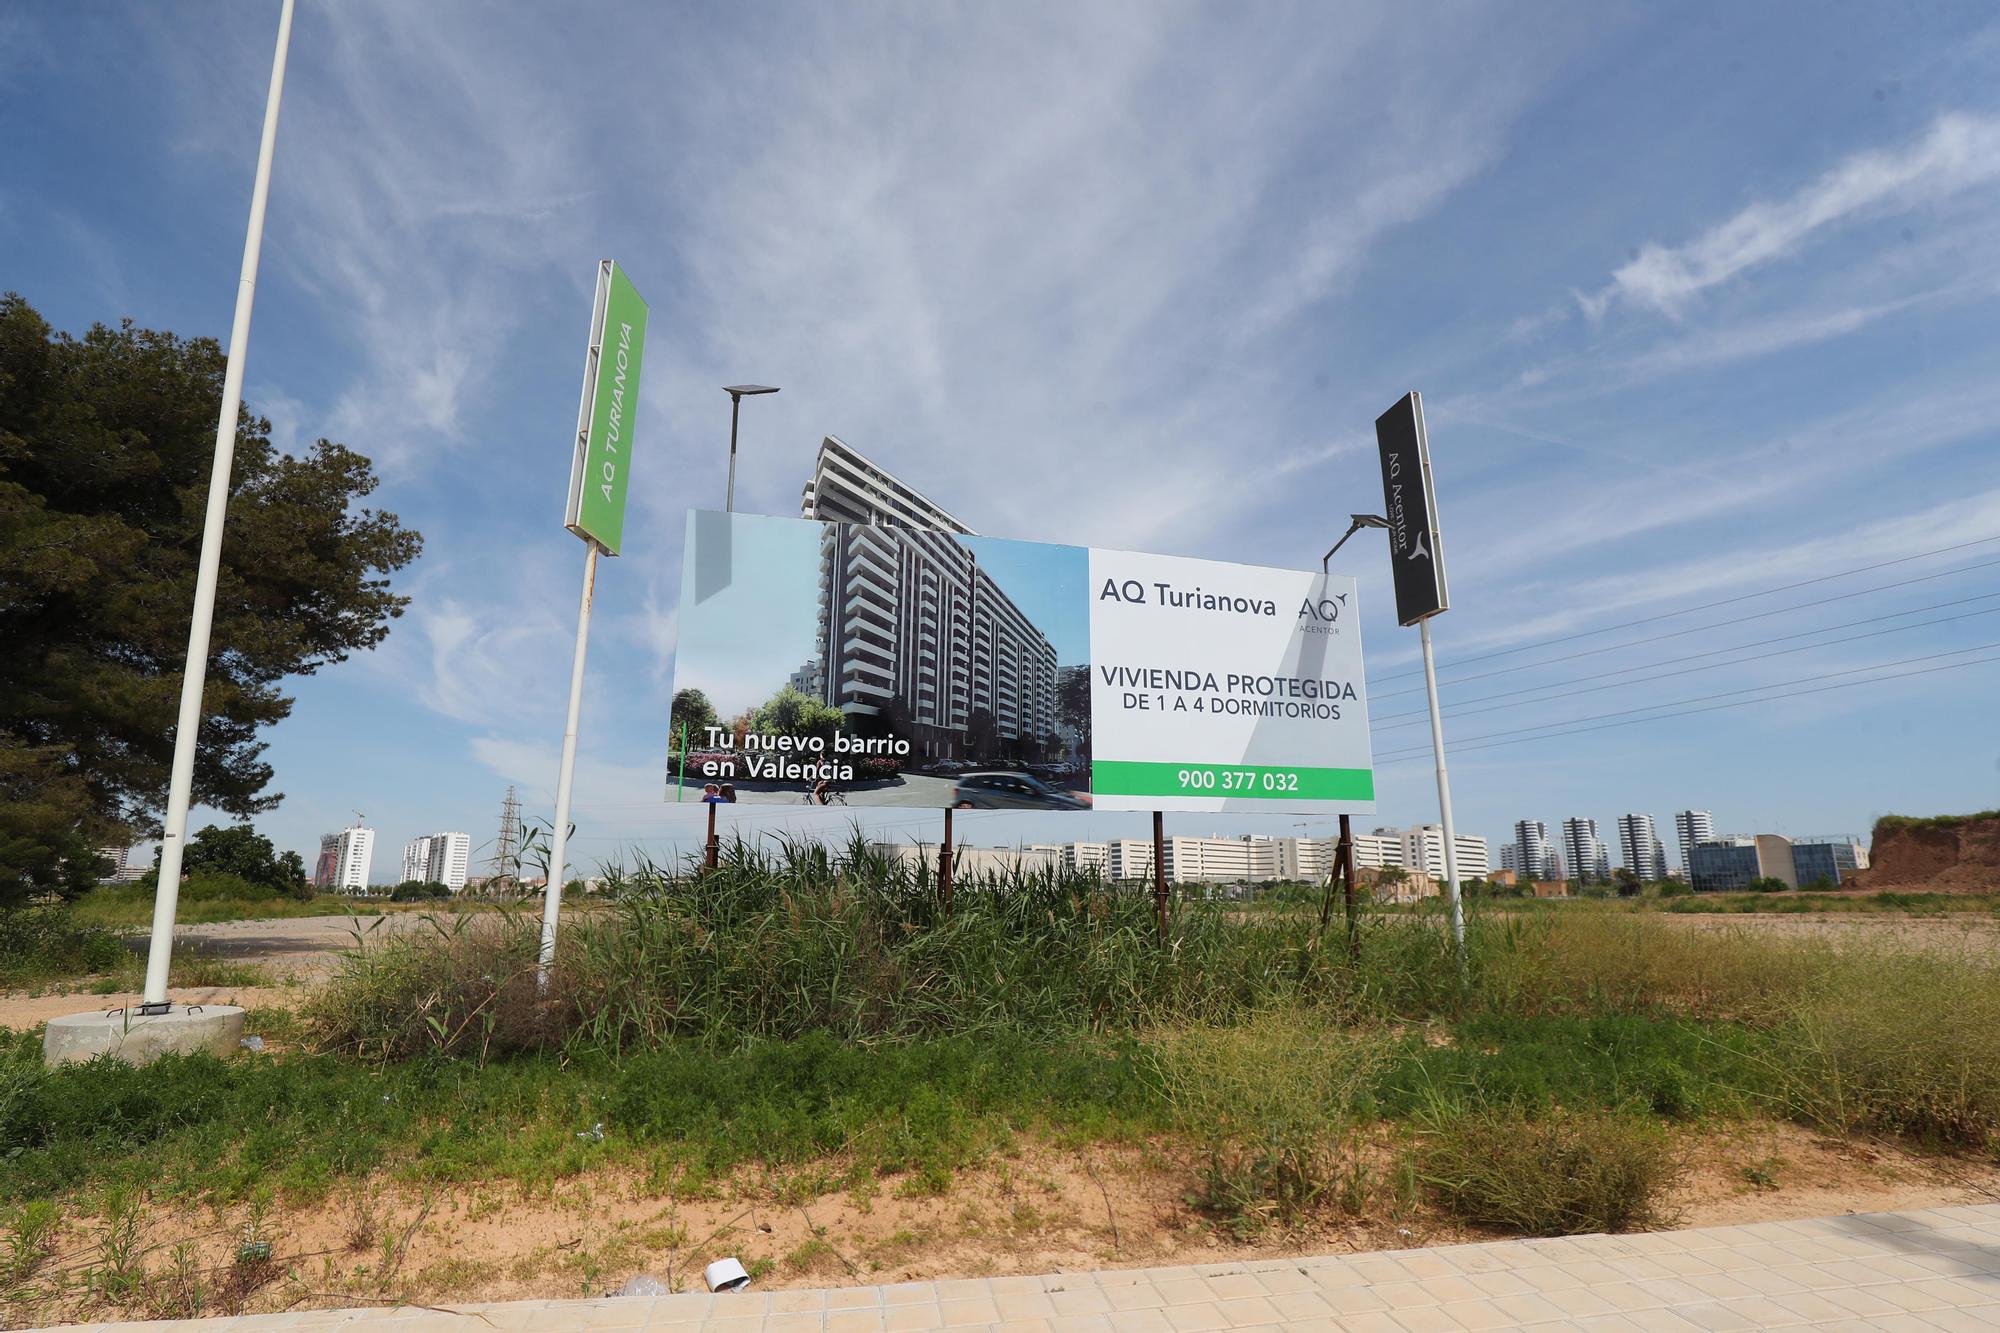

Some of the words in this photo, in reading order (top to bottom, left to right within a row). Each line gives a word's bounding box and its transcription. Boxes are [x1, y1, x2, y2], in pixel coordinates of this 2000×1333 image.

[606, 322, 632, 453] TURIANOVA
[1389, 453, 1400, 479] AQ
[601, 462, 615, 502] AQ
[1393, 484, 1407, 549] Acentor
[1100, 578, 1146, 604] AQ
[1153, 583, 1276, 616] Turianova
[1299, 598, 1338, 622] AQ
[1299, 625, 1340, 635] ACENTOR
[1100, 665, 1219, 692] VIVIENDA
[1227, 674, 1357, 701] PROTEGIDA
[1123, 693, 1149, 710] DE
[1157, 695, 1165, 711] 1
[1174, 696, 1187, 712] A
[1193, 697, 1204, 713] 4
[1211, 698, 1341, 720] DORMITORIOS
[704, 726, 734, 749] Tu
[744, 733, 825, 751] nuevo
[834, 730, 910, 755] barrio
[702, 760, 735, 777] en
[745, 756, 853, 780] Valencia
[1178, 770, 1215, 789] 900
[1221, 771, 1256, 790] 377
[1263, 773, 1298, 791] 032
